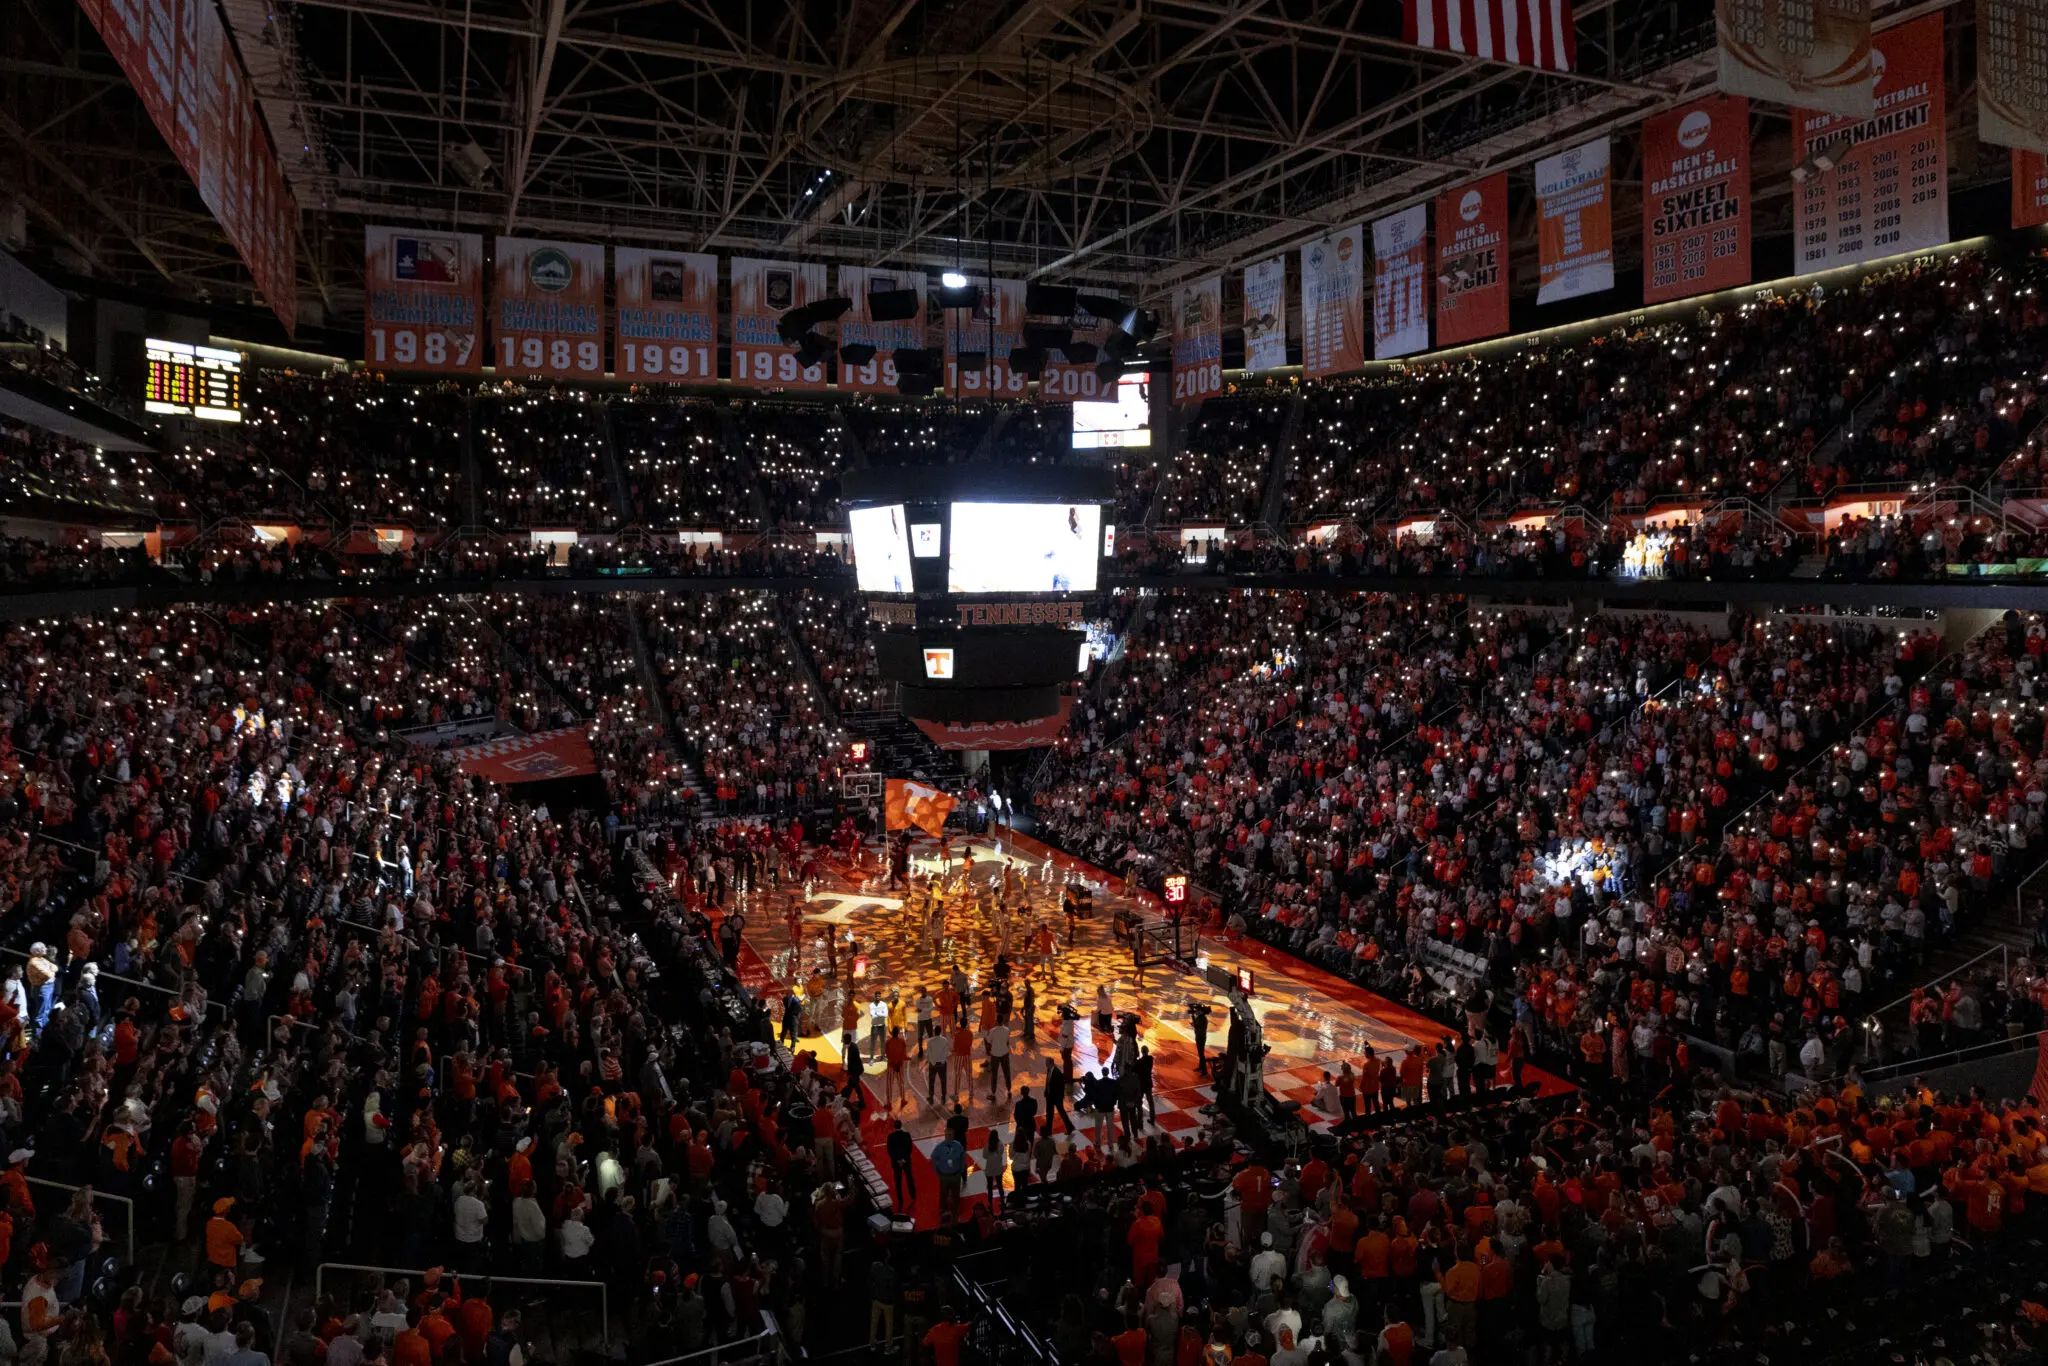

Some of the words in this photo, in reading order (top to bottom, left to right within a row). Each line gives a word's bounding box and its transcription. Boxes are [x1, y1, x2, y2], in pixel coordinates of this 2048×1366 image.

[1778, 18, 1813, 39] 2004
[1875, 82, 1929, 109] KETBALL
[1806, 103, 1929, 153] TOURNAMENT
[1672, 150, 1715, 173] MEN'S
[1872, 151, 1897, 166] 2001
[1911, 139, 1936, 155] 2011
[1651, 158, 1738, 195] BASKETBALL
[1873, 168, 1899, 181] 2006
[1911, 156, 1937, 171] 2014
[1663, 182, 1728, 216] SWEET
[1804, 202, 1826, 215] 1977
[1873, 183, 1899, 198] 2007
[1912, 172, 1937, 187] 2018
[1653, 198, 1739, 236] SIXTEEN
[1804, 217, 1826, 230] 1979
[1838, 209, 1861, 222] 1998
[1873, 199, 1900, 214] 2008
[1912, 188, 1937, 204] 2019
[1456, 223, 1485, 241] MEN'S
[1655, 243, 1675, 257] 1967
[1683, 235, 1706, 250] 2007
[1713, 228, 1736, 243] 2014
[1805, 232, 1827, 246] 1980
[1838, 224, 1861, 238] 1999
[1873, 215, 1901, 230] 2009
[1442, 231, 1500, 257] BASKETBALL
[1805, 248, 1826, 261] 1981
[1838, 240, 1863, 255] 2000
[1874, 231, 1900, 246] 2010
[1655, 259, 1674, 272] 1981
[1682, 251, 1706, 266] 2008
[1713, 243, 1737, 258] 2019
[1913, 255, 1935, 268] 321
[1654, 273, 1677, 287] 2000
[1683, 266, 1705, 281] 2010
[371, 292, 473, 311] NATIONAL
[1756, 288, 1774, 300] 320
[371, 304, 474, 325] CHAMPIONS
[502, 302, 597, 319] NATIONAL
[620, 309, 711, 328] NATIONAL
[1628, 315, 1645, 326] 319
[501, 316, 597, 333] CHAMPIONS
[620, 324, 712, 342] CHAMPIONS
[843, 323, 922, 342] NATIONAL
[371, 329, 475, 366] 1987
[501, 336, 599, 371] 1989
[1527, 336, 1540, 346] 318
[623, 343, 709, 377] 1991
[735, 350, 822, 383] 1996
[844, 358, 900, 386] 199
[947, 363, 1024, 392] 1998
[1175, 364, 1221, 399] 2008
[1241, 372, 1254, 380] 317
[956, 602, 1085, 626] TENNESSEE
[926, 653, 950, 674] T
[947, 721, 1007, 733] ROCKY
[903, 781, 940, 820] T
[1165, 876, 1186, 888] 20:00
[1169, 885, 1184, 901] 30
[803, 891, 904, 925] T
